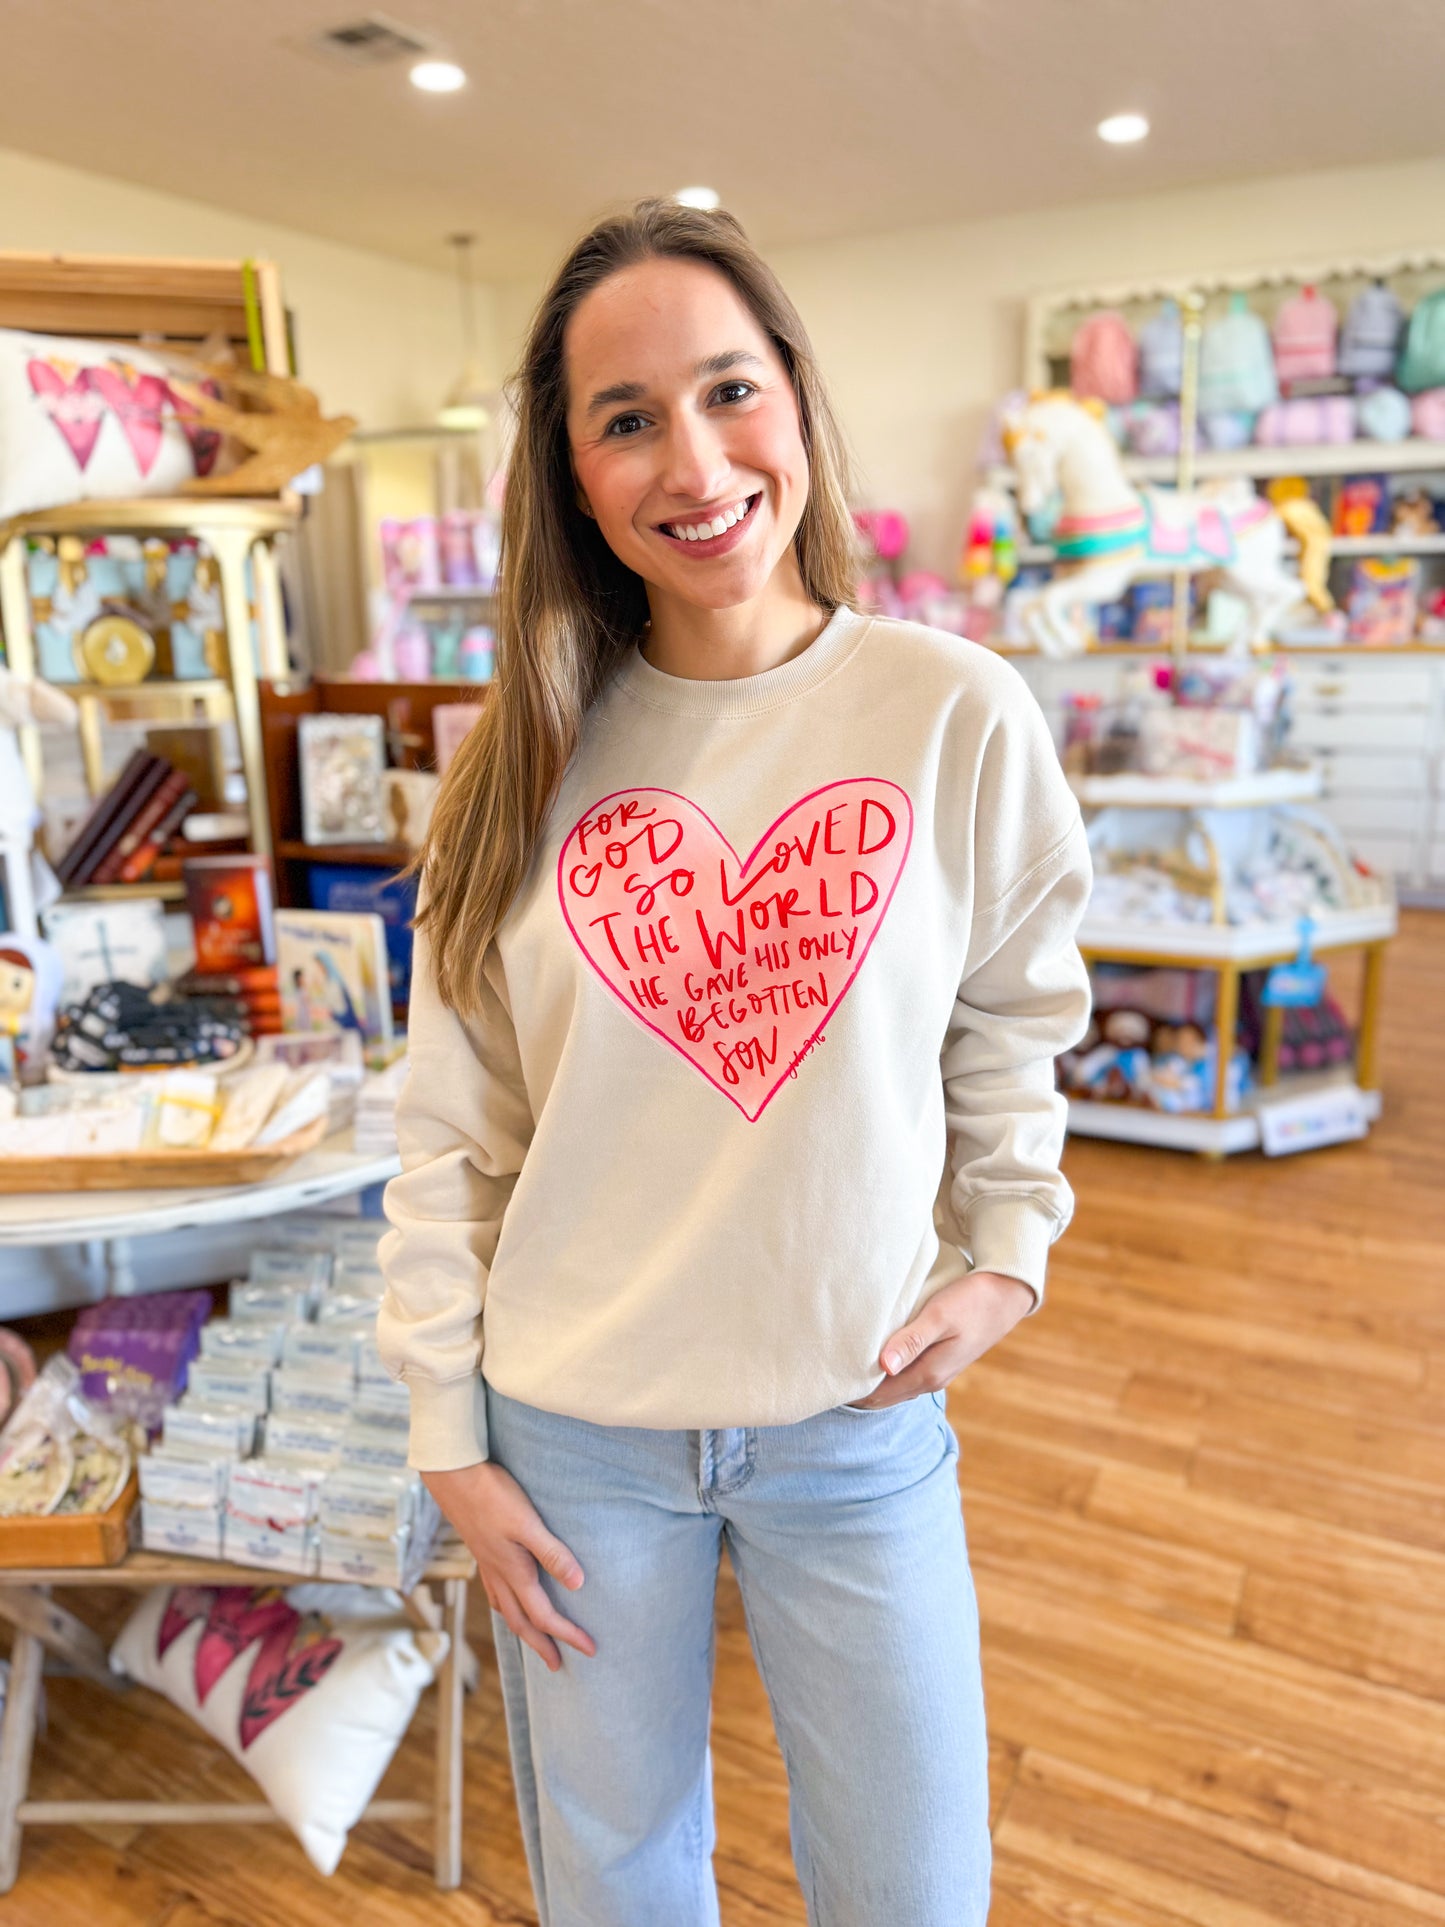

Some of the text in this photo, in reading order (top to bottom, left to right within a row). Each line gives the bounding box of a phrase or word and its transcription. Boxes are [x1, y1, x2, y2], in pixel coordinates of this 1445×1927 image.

[569, 819, 683, 897] GOD
[579, 800, 657, 855] FOR
[624, 799, 896, 915] SO LOVED
[589, 871, 878, 970] THE WORLD
[629, 926, 858, 1009] HE GAVE HIS ONLY
[677, 972, 828, 1042] BEGOTTEN
[713, 1026, 777, 1084] SON
